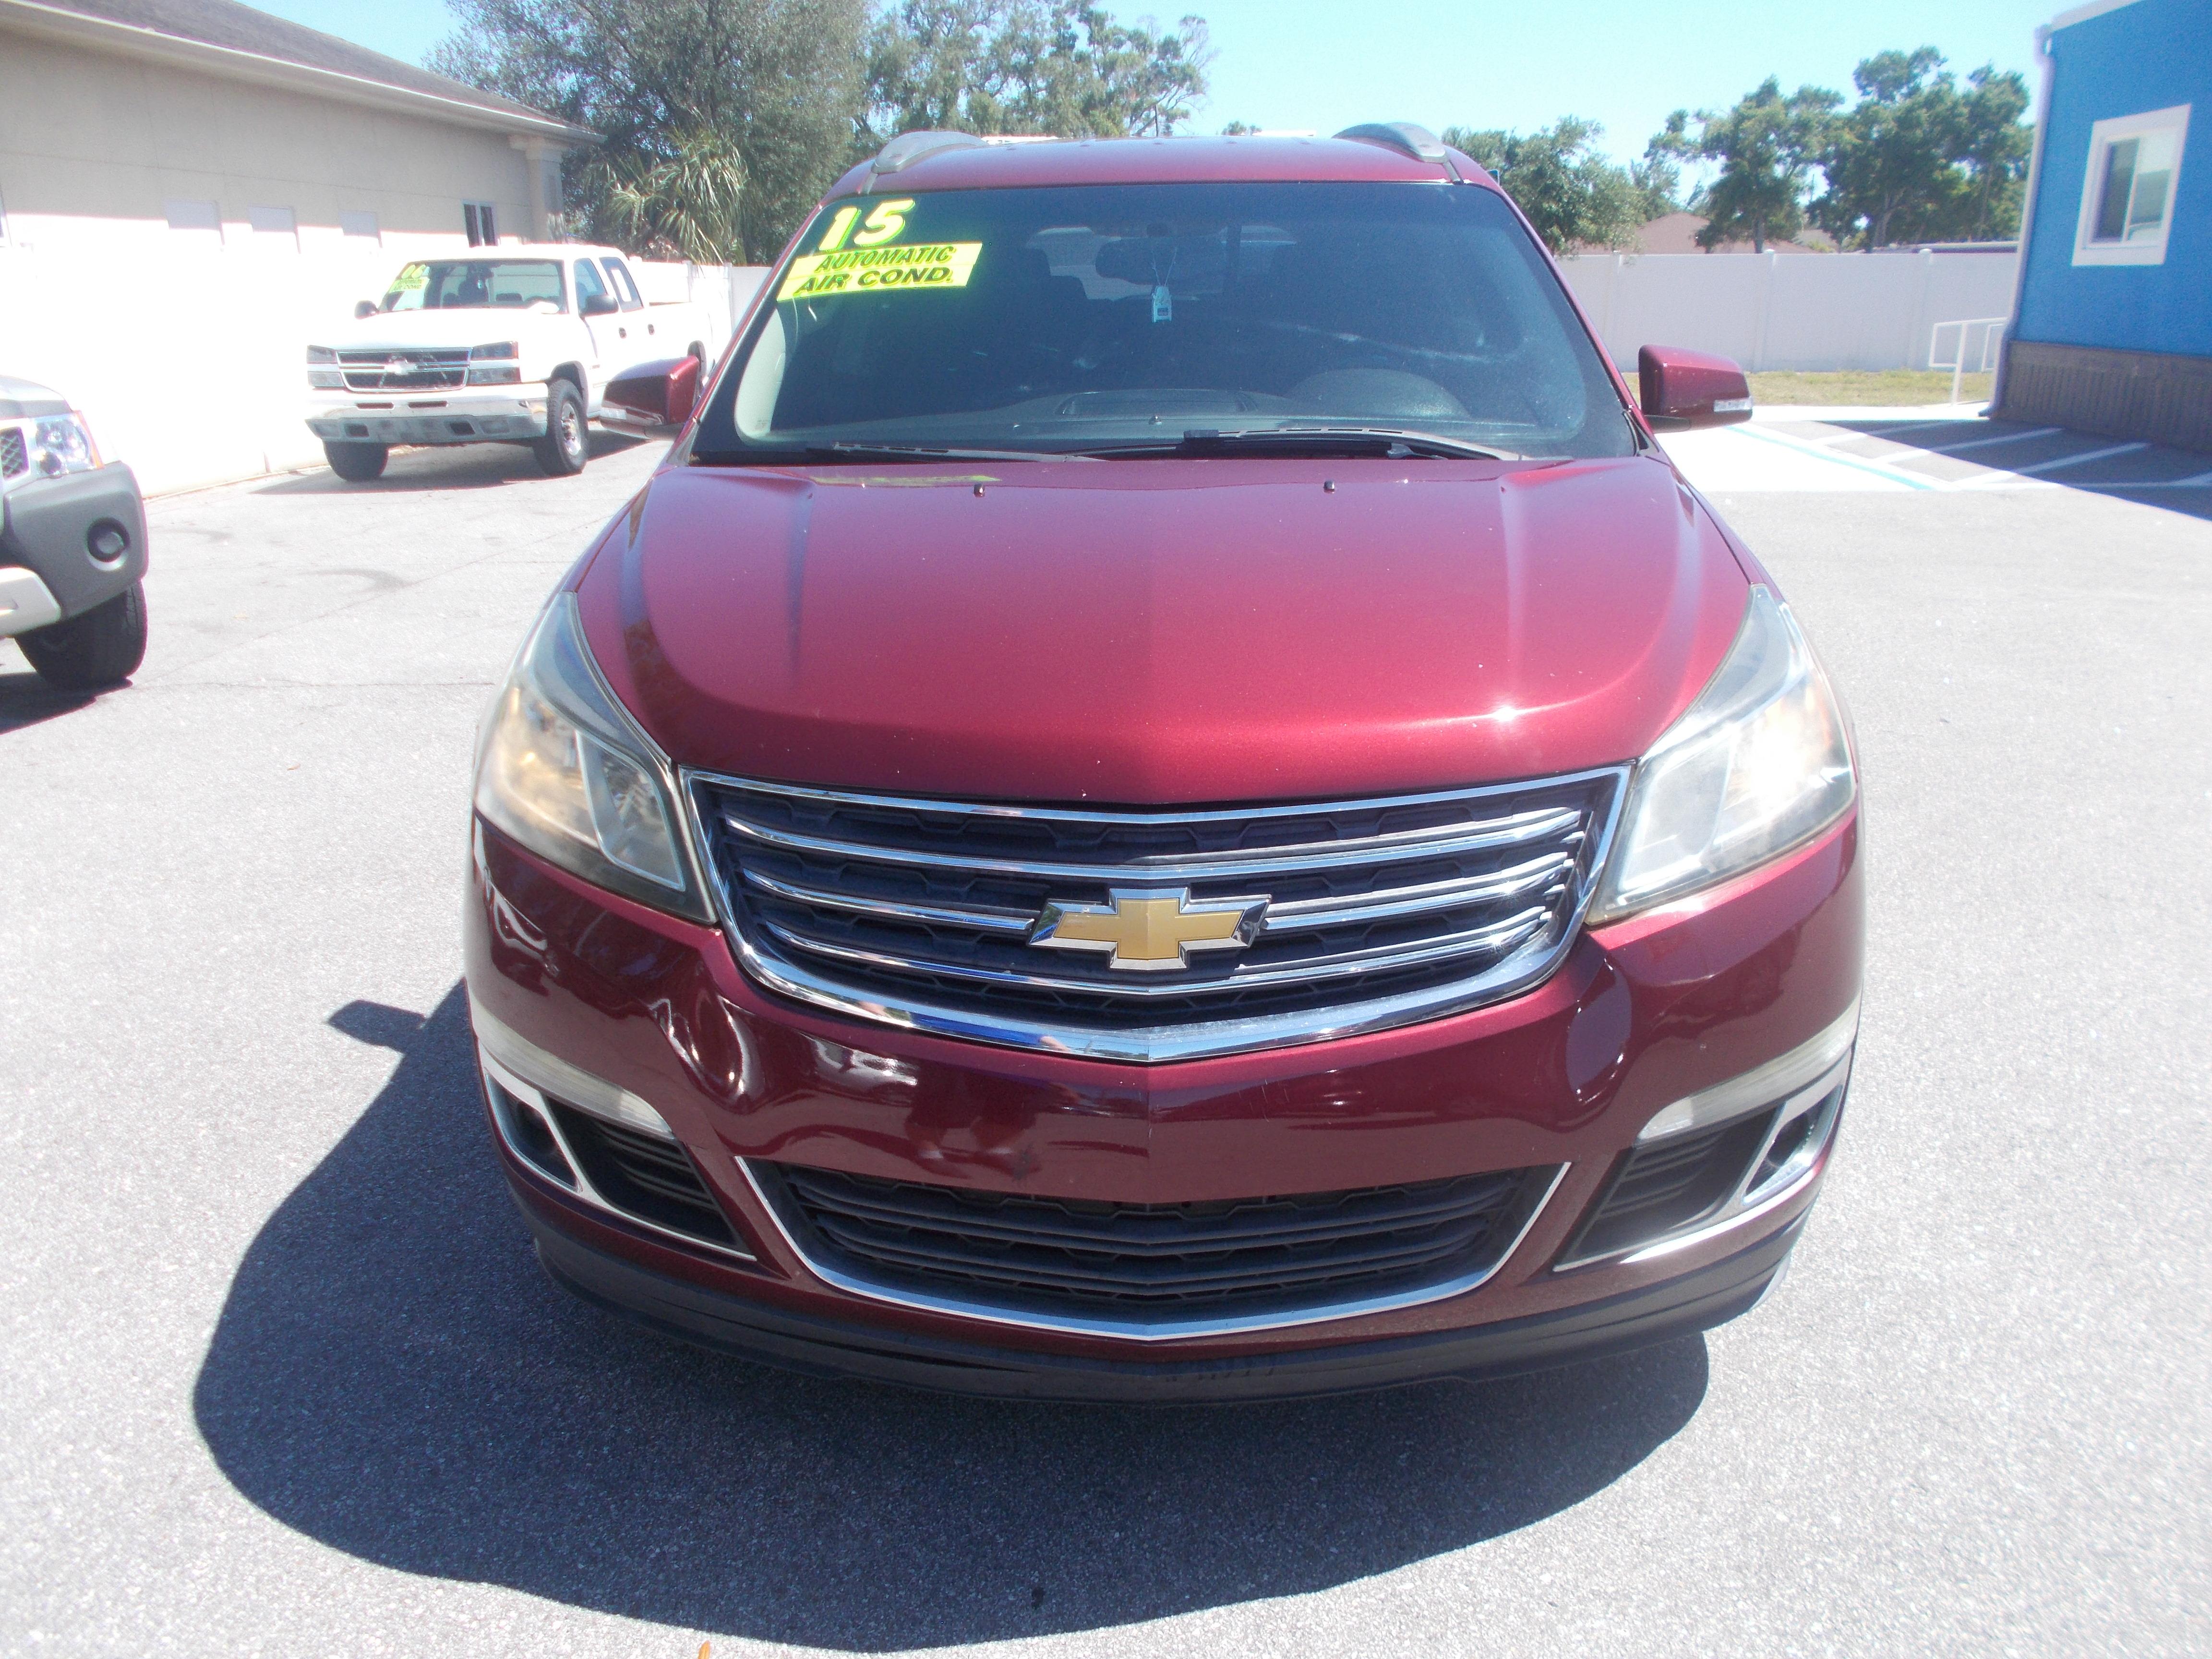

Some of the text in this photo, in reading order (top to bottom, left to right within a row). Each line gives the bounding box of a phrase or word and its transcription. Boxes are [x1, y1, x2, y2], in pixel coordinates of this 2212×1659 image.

[819, 199, 916, 251] 15
[815, 246, 956, 273] AUTOMATIC
[793, 267, 953, 296] AIR COND.
